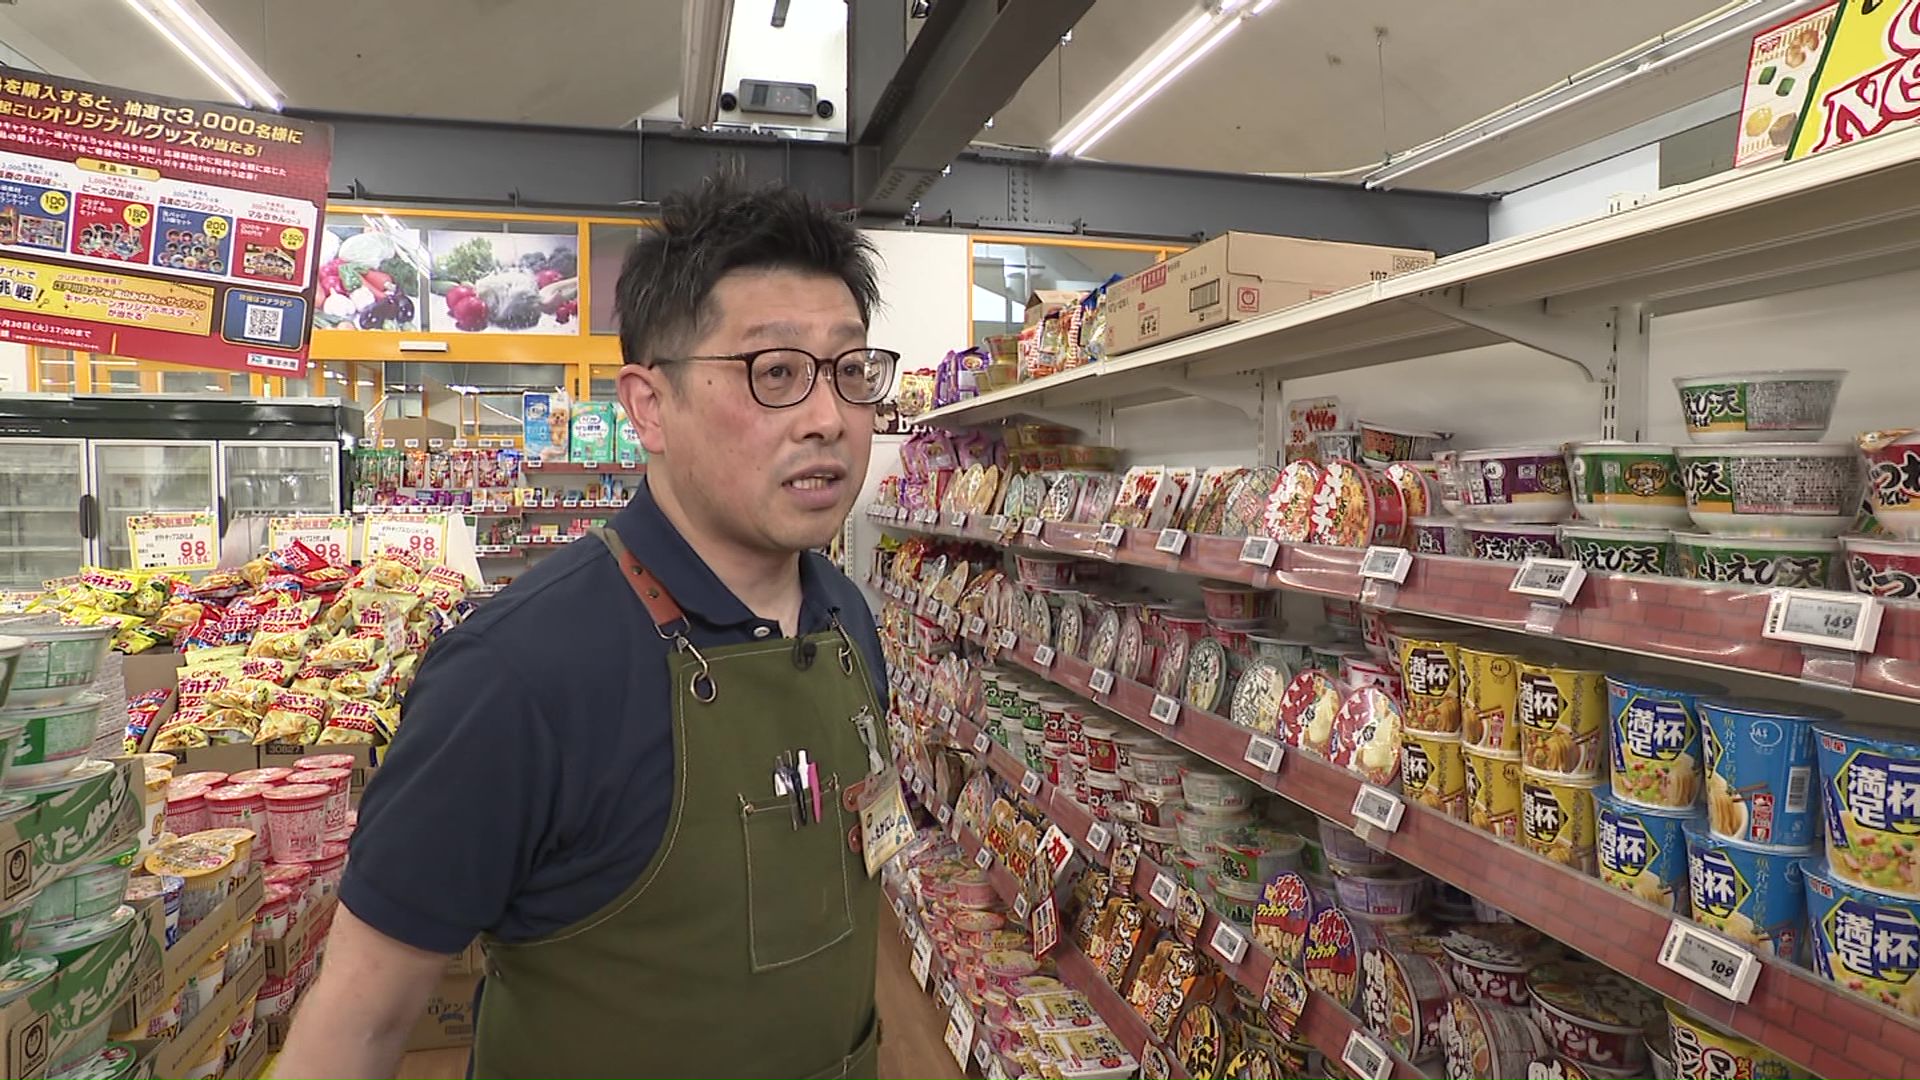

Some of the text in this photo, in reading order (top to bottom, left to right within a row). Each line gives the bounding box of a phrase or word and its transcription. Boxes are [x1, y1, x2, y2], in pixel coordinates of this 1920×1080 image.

[0, 76, 303, 144] を購入すると、抽選で3,000名様に
[45, 195, 65, 206] 100
[127, 208, 147, 220] 150
[206, 220, 226, 231] 200
[180, 540, 206, 557] 98
[315, 543, 341, 559] 98
[409, 535, 435, 551] 98
[1700, 552, 1825, 588] 小えび天
[1823, 613, 1853, 630] 149
[1627, 705, 1686, 758] 一杯 満足
[1750, 727, 1768, 738] JAS
[1848, 763, 1888, 830] 満足
[1615, 820, 1647, 864] 一杯
[1703, 853, 1736, 904] 一杯
[1835, 909, 1919, 975] 一杯 満足
[1710, 958, 1735, 978] 109
